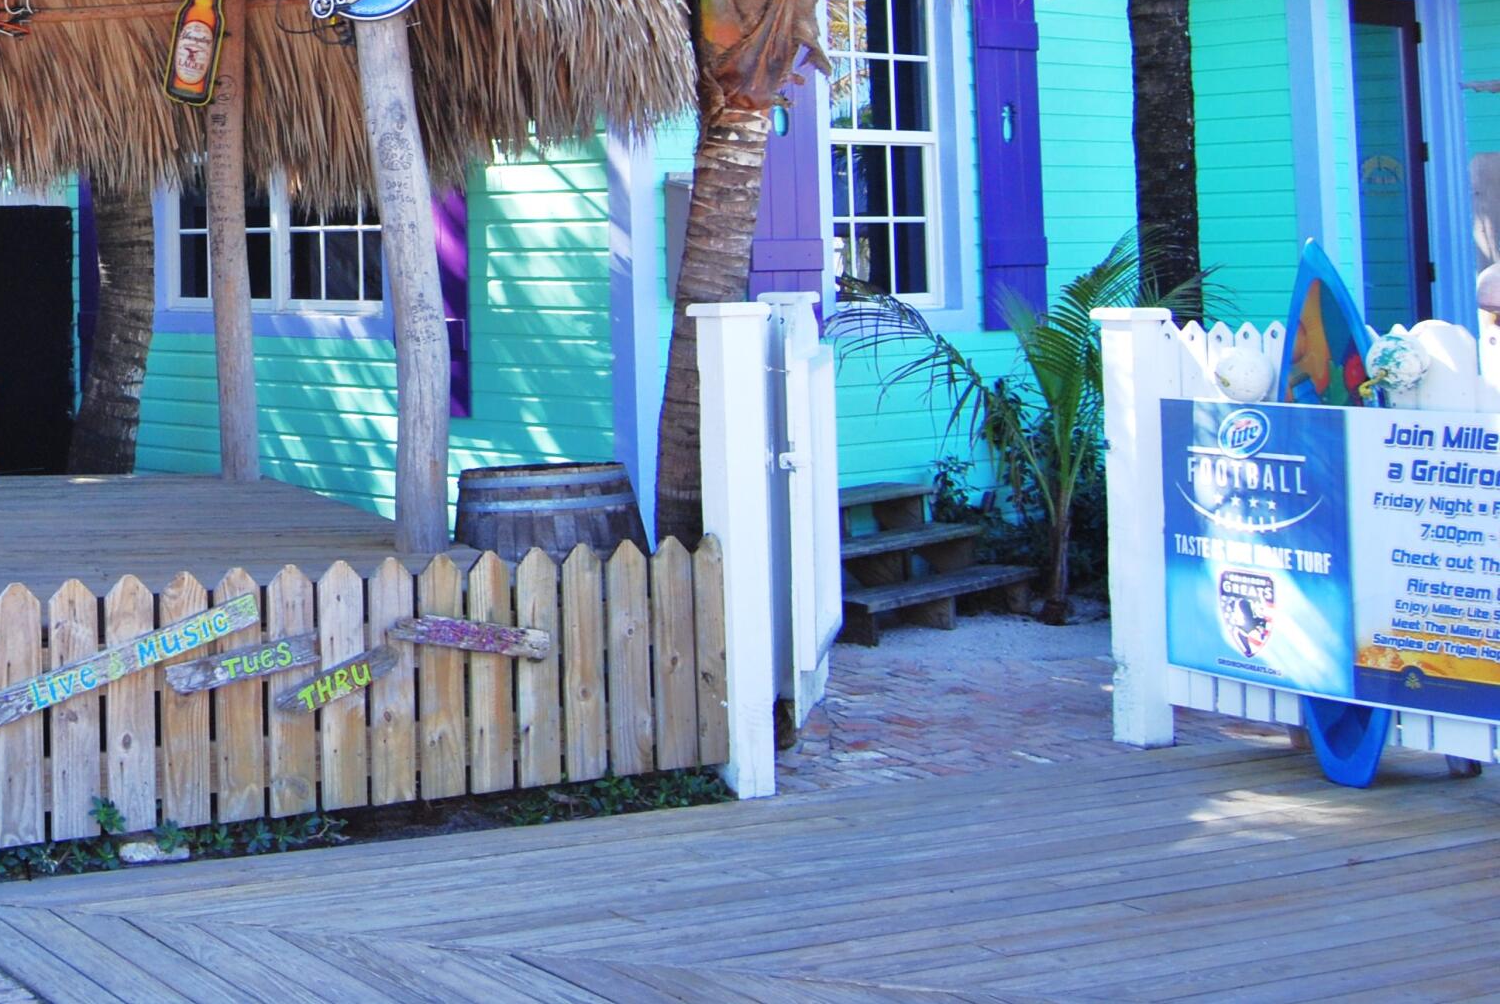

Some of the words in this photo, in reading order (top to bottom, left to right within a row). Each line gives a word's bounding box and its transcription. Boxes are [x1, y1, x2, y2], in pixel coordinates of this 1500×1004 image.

[1230, 425, 1259, 447] Lite
[1384, 423, 1435, 448] Join
[1187, 456, 1308, 495] FOOTBALL
[1387, 462, 1403, 480] a
[1373, 492, 1424, 513] Friday
[1429, 496, 1473, 516] Night
[1421, 523, 1483, 543] 7:00pm
[1174, 533, 1211, 559] TASTE
[1295, 548, 1332, 575] TURF
[1391, 548, 1440, 567] Check
[1446, 556, 1474, 570] out
[1222, 580, 1274, 601] GREATS
[1407, 577, 1492, 600] Airstream
[1395, 599, 1428, 616] Enjoy
[1432, 603, 1463, 617] Miller
[1467, 606, 1490, 620] Lite
[1391, 617, 1421, 631] Meet
[1425, 621, 1447, 634] The
[1450, 625, 1483, 639] Miller
[1373, 633, 1424, 652] Samples
[1427, 640, 1441, 652] of
[1444, 642, 1478, 658] Triple
[296, 662, 373, 713] THRU
